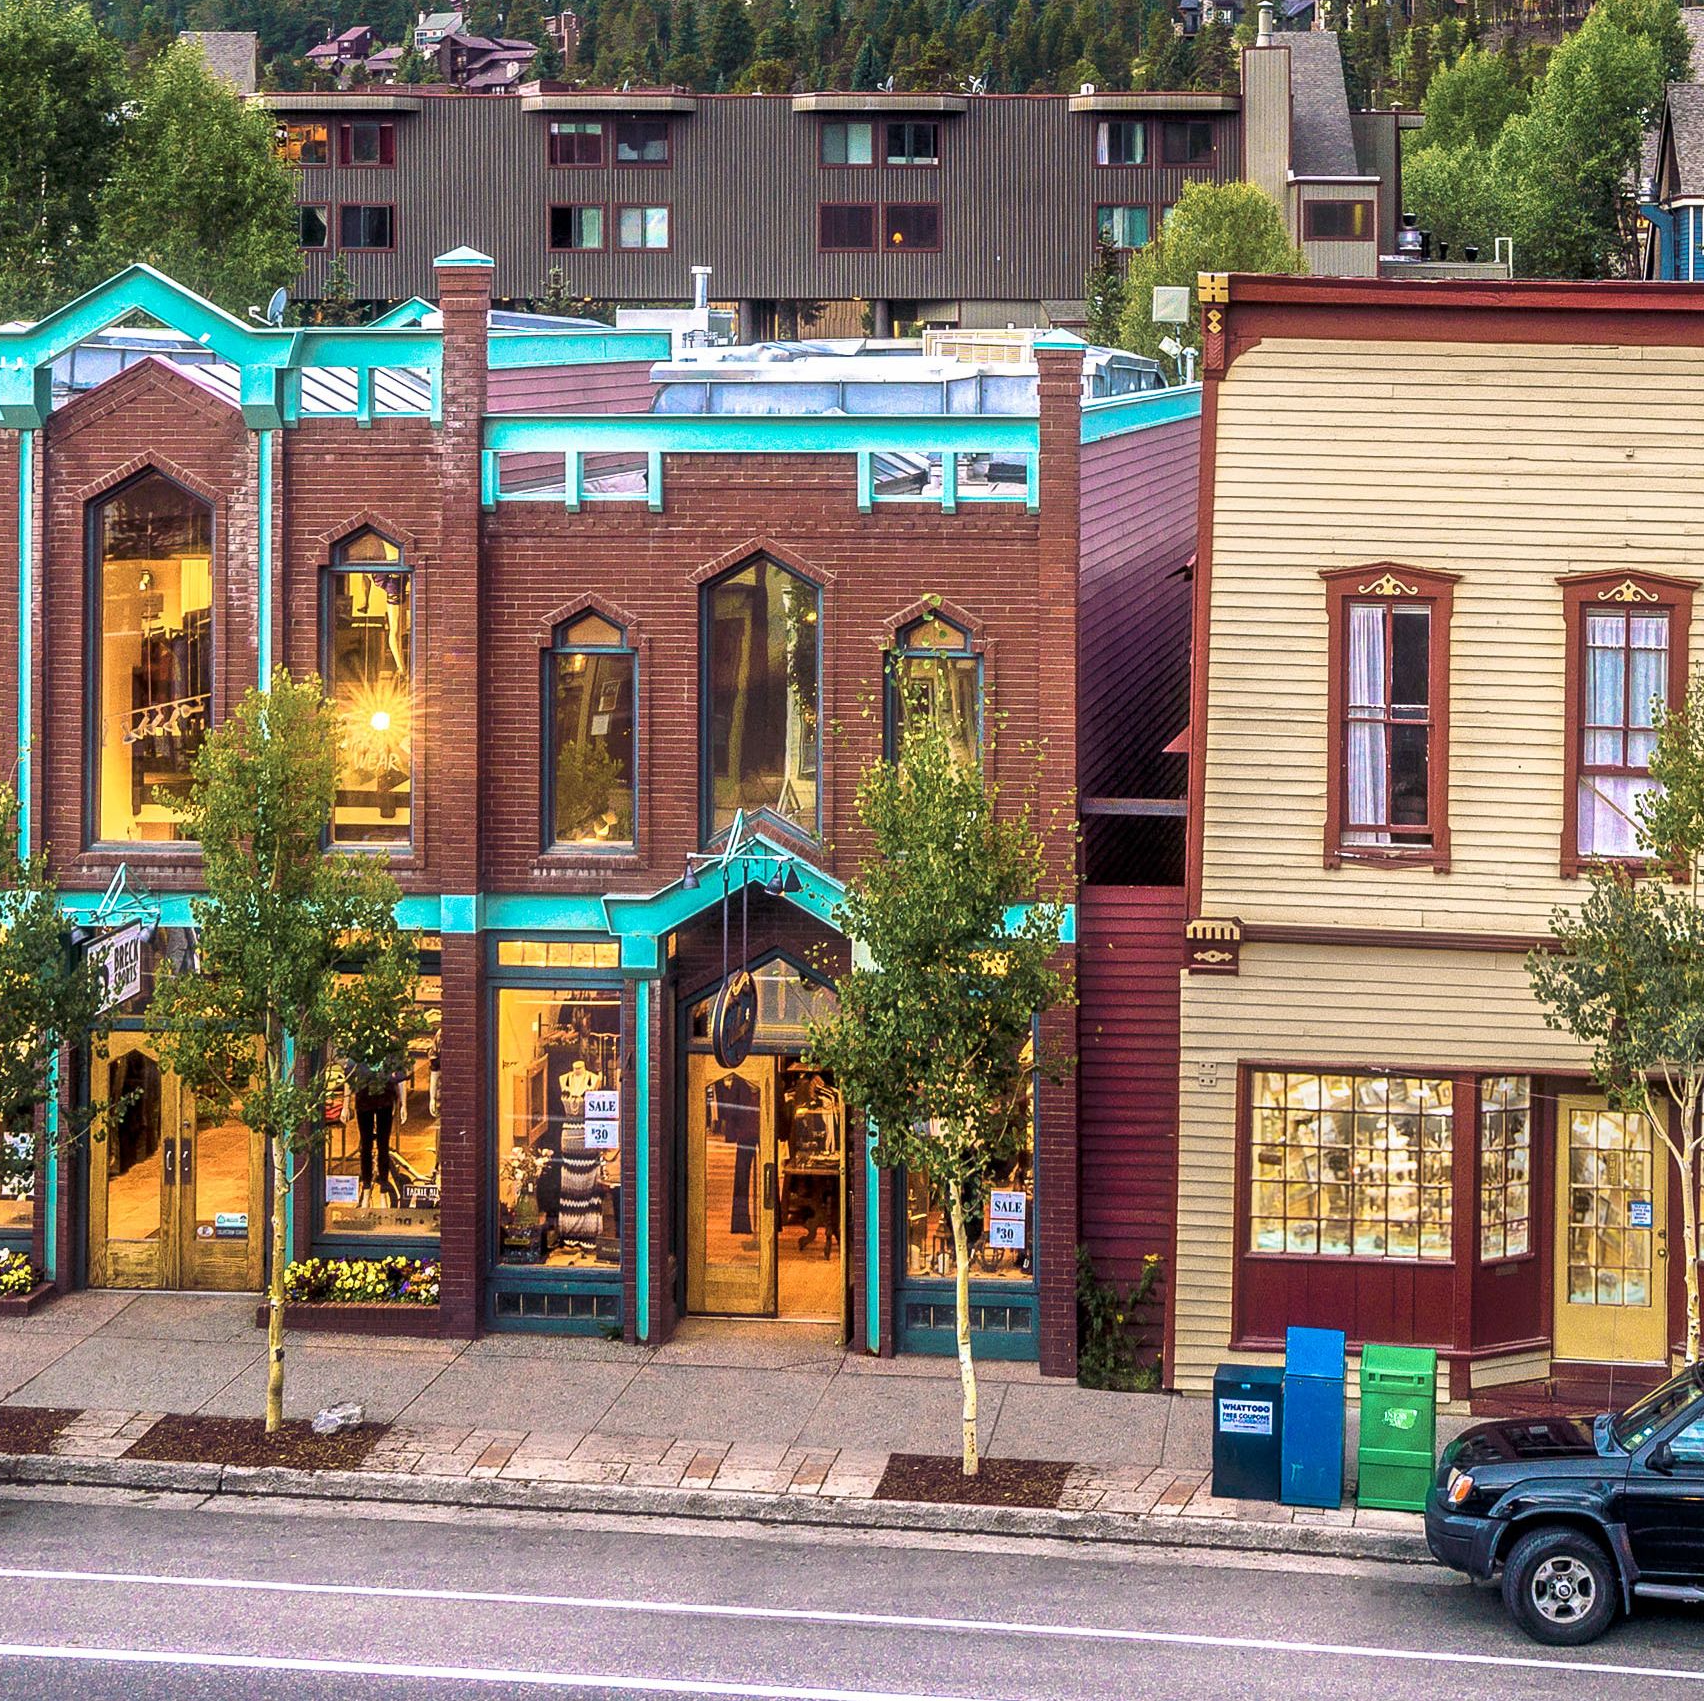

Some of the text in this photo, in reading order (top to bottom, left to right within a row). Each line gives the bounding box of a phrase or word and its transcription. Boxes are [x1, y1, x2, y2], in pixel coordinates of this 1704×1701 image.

[114, 937, 139, 974] BRECK
[588, 1100, 616, 1112] SALE
[591, 1128, 609, 1140] $30
[994, 1200, 1023, 1214] SALE
[996, 1226, 1014, 1240] $30
[1238, 1413, 1270, 1421] COUPONS
